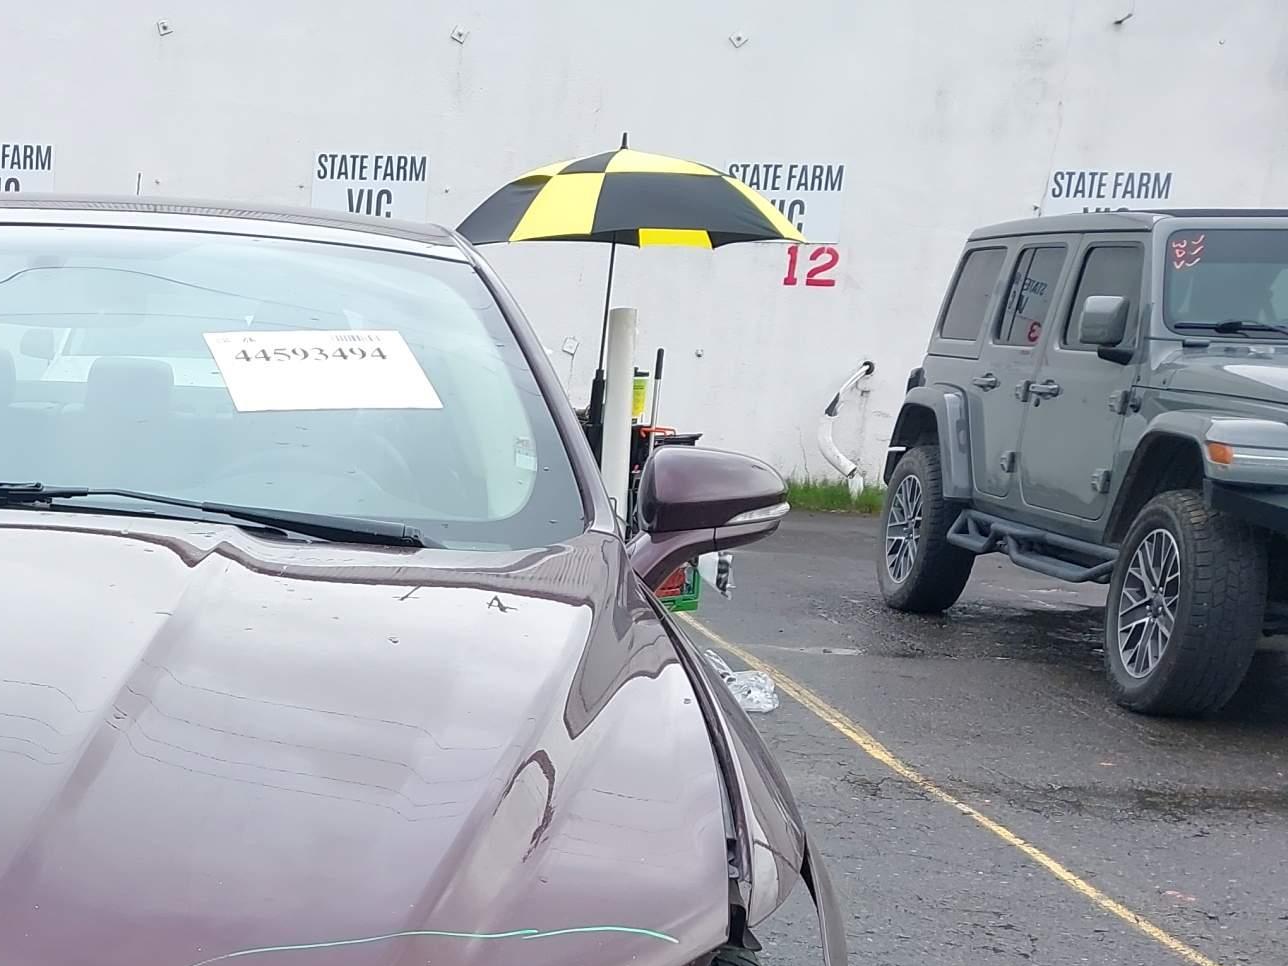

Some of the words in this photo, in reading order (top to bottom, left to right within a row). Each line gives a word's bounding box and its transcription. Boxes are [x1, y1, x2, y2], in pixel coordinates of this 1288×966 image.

[1, 144, 52, 170] FARM
[317, 153, 369, 180] STATE
[373, 155, 427, 182] FARM
[786, 164, 844, 191] FARM
[1052, 171, 1108, 198] STATE
[1112, 172, 1172, 199] FARM
[783, 245, 839, 287] 12
[234, 347, 388, 362] 44593494
